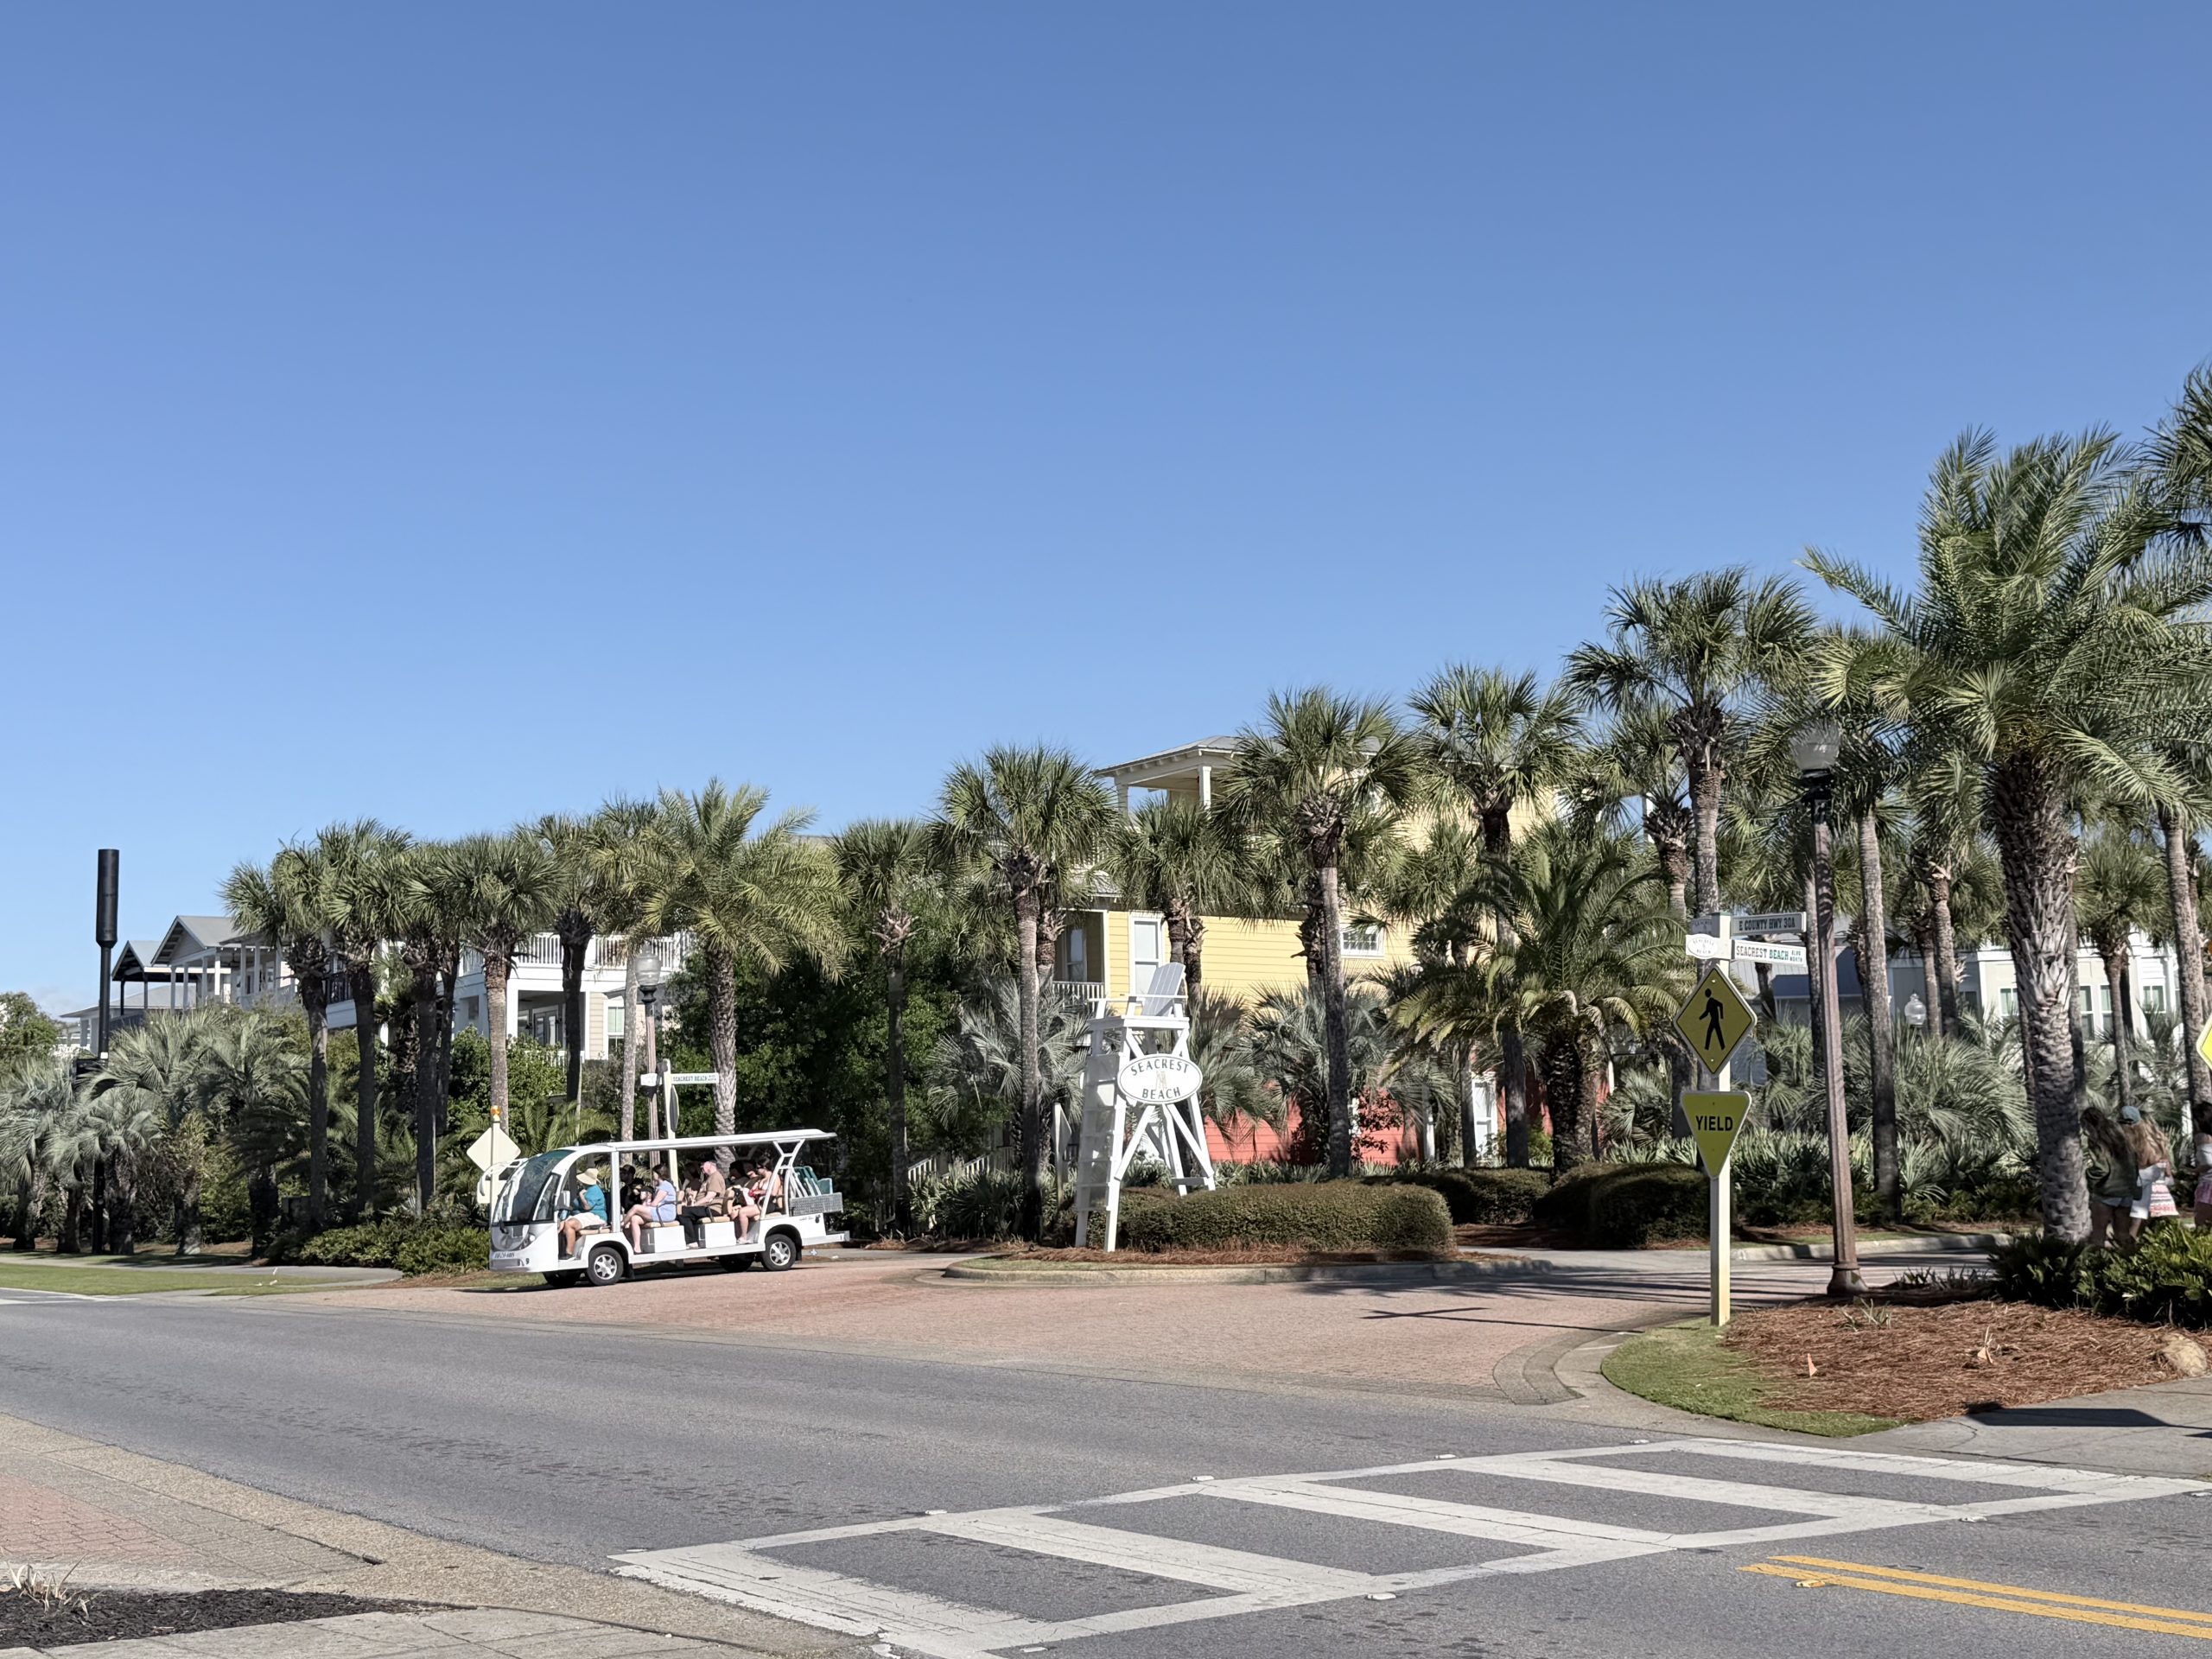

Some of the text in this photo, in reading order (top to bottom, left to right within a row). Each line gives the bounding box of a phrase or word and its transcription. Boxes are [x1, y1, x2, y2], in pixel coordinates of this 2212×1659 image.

[1738, 917, 1796, 931] E COUNTY HWY 30A
[1736, 945, 1789, 961] SEACREST BEACH
[1130, 1058, 1190, 1077] SEACREST
[1141, 1087, 1181, 1100] BEACH
[1695, 1116, 1733, 1131] YIELD
